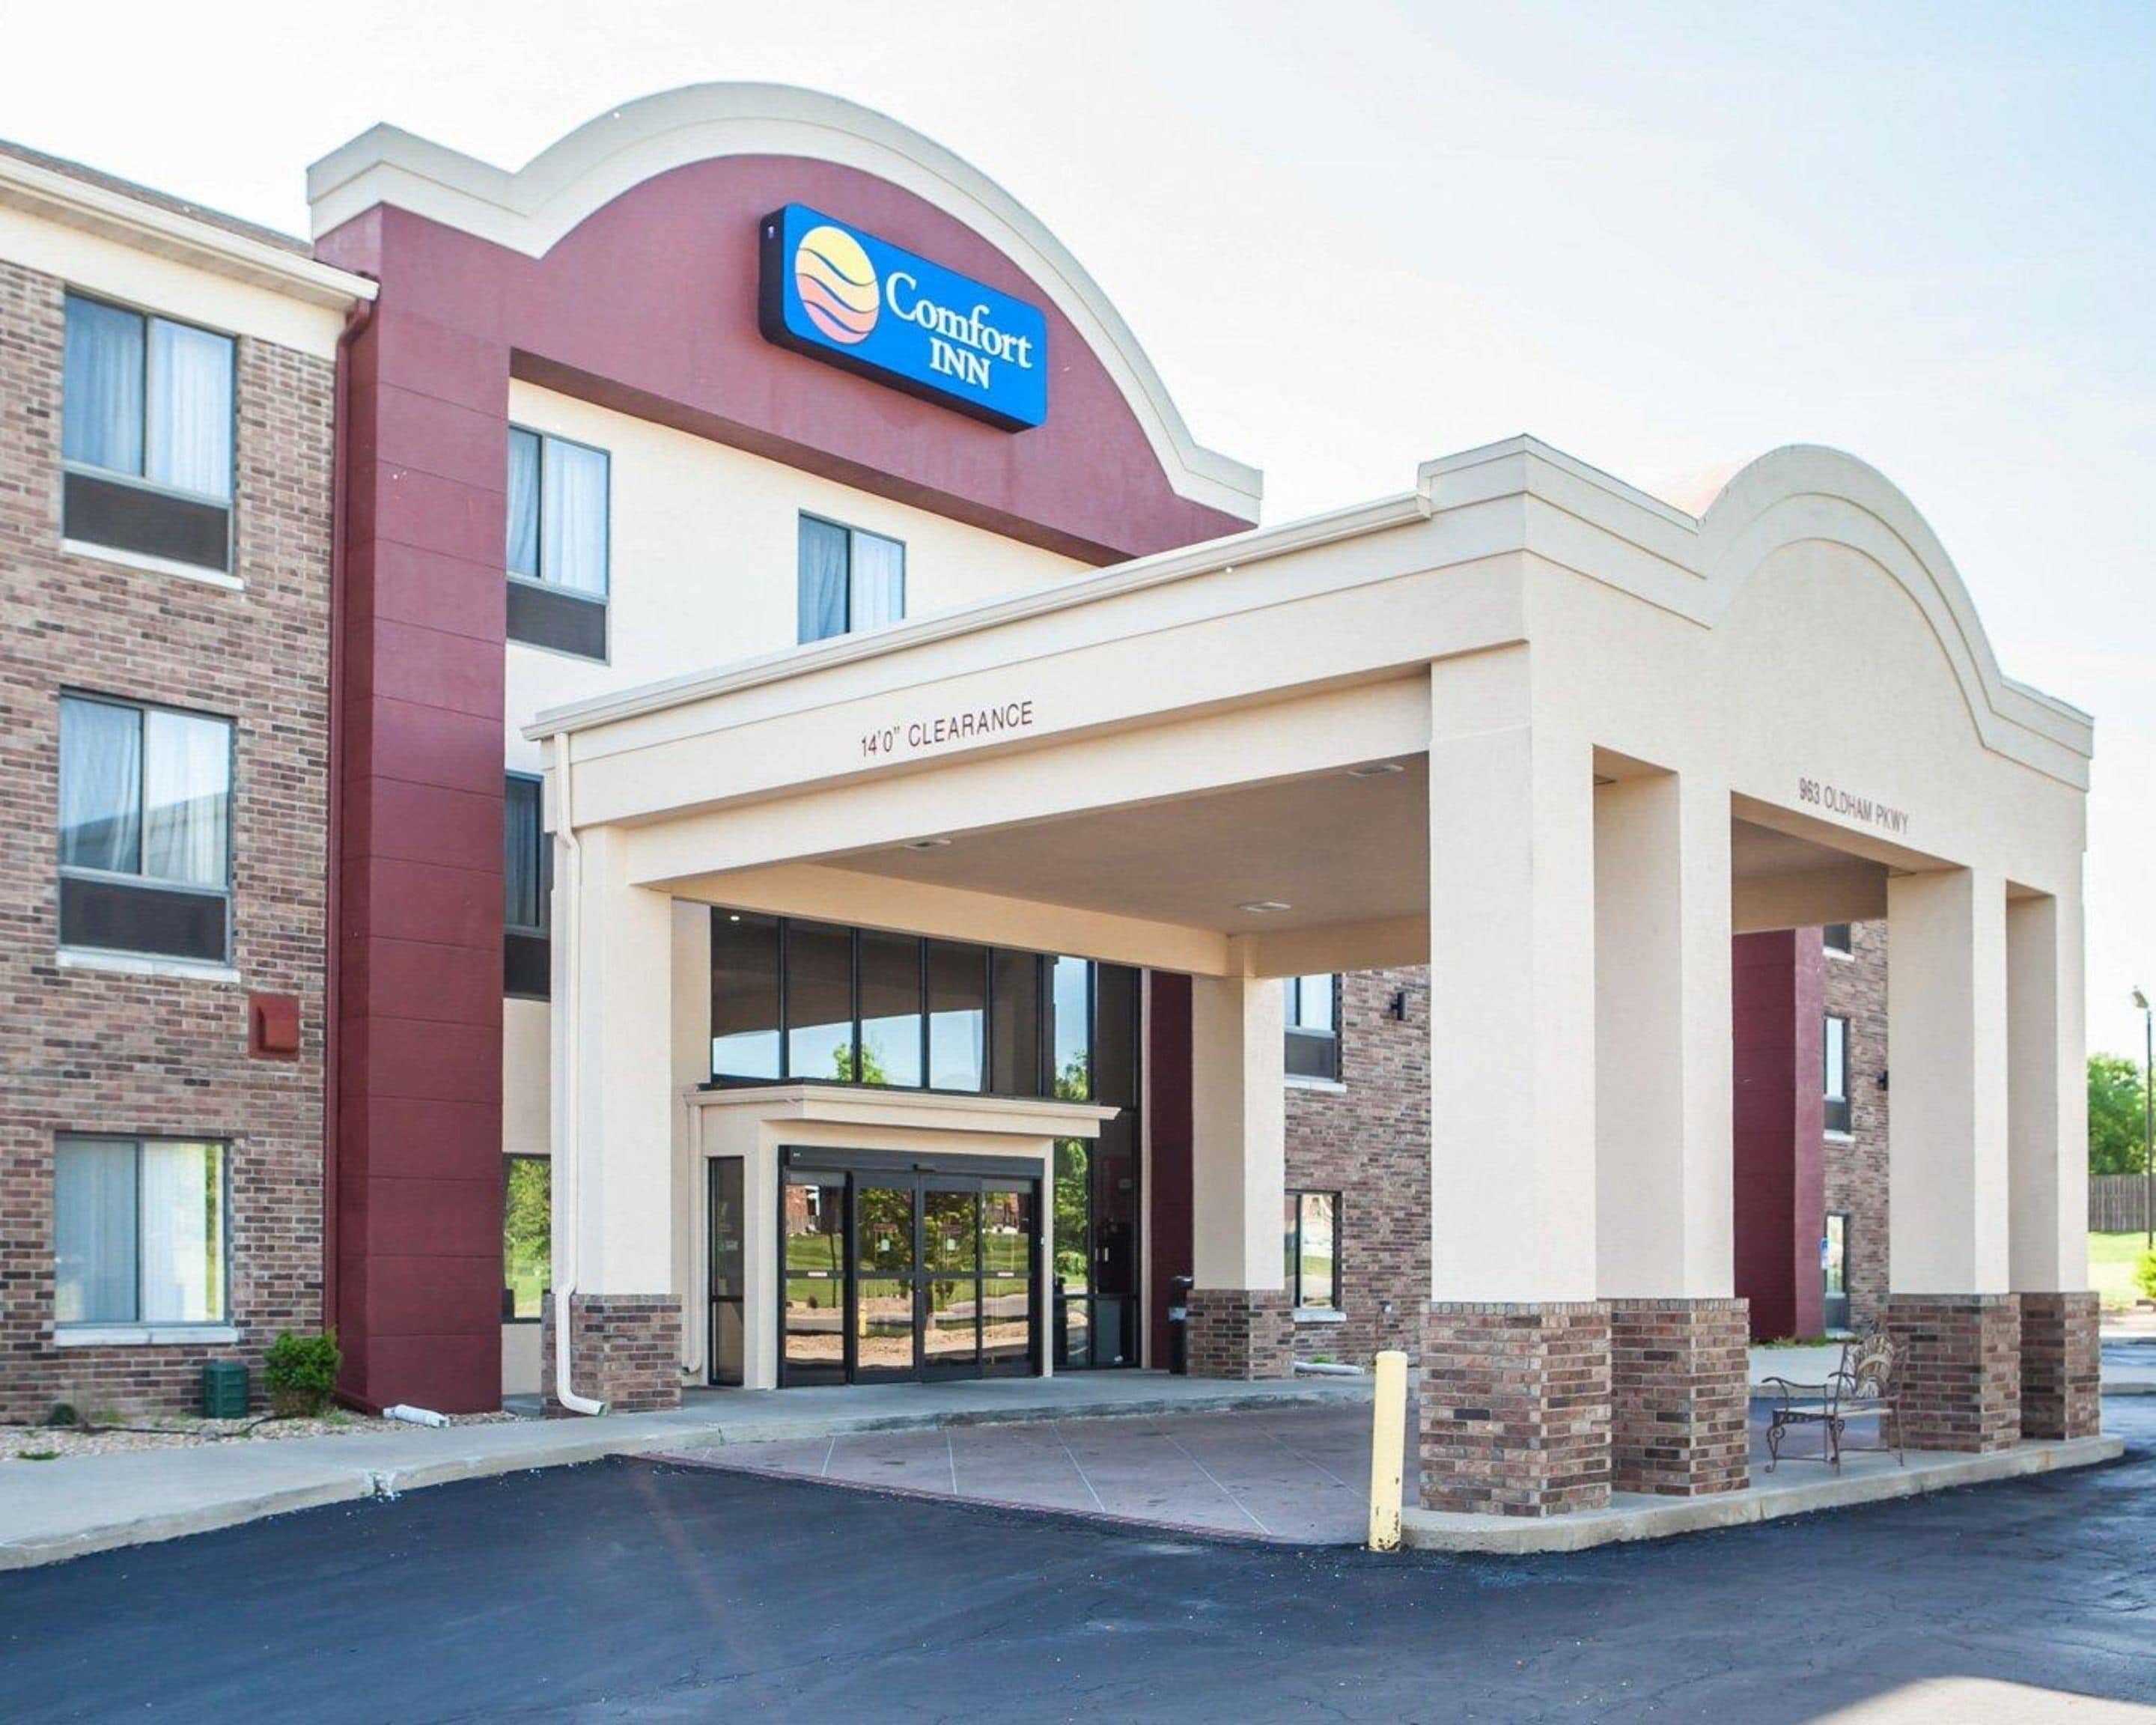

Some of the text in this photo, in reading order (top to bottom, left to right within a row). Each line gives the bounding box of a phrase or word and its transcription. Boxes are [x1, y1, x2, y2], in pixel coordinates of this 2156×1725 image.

[886, 272, 1033, 369] Comfort
[929, 337, 990, 389] INN
[908, 701, 1033, 747] CLEARANCE
[1799, 777, 1909, 834] 963 OLDHAM PKWY
